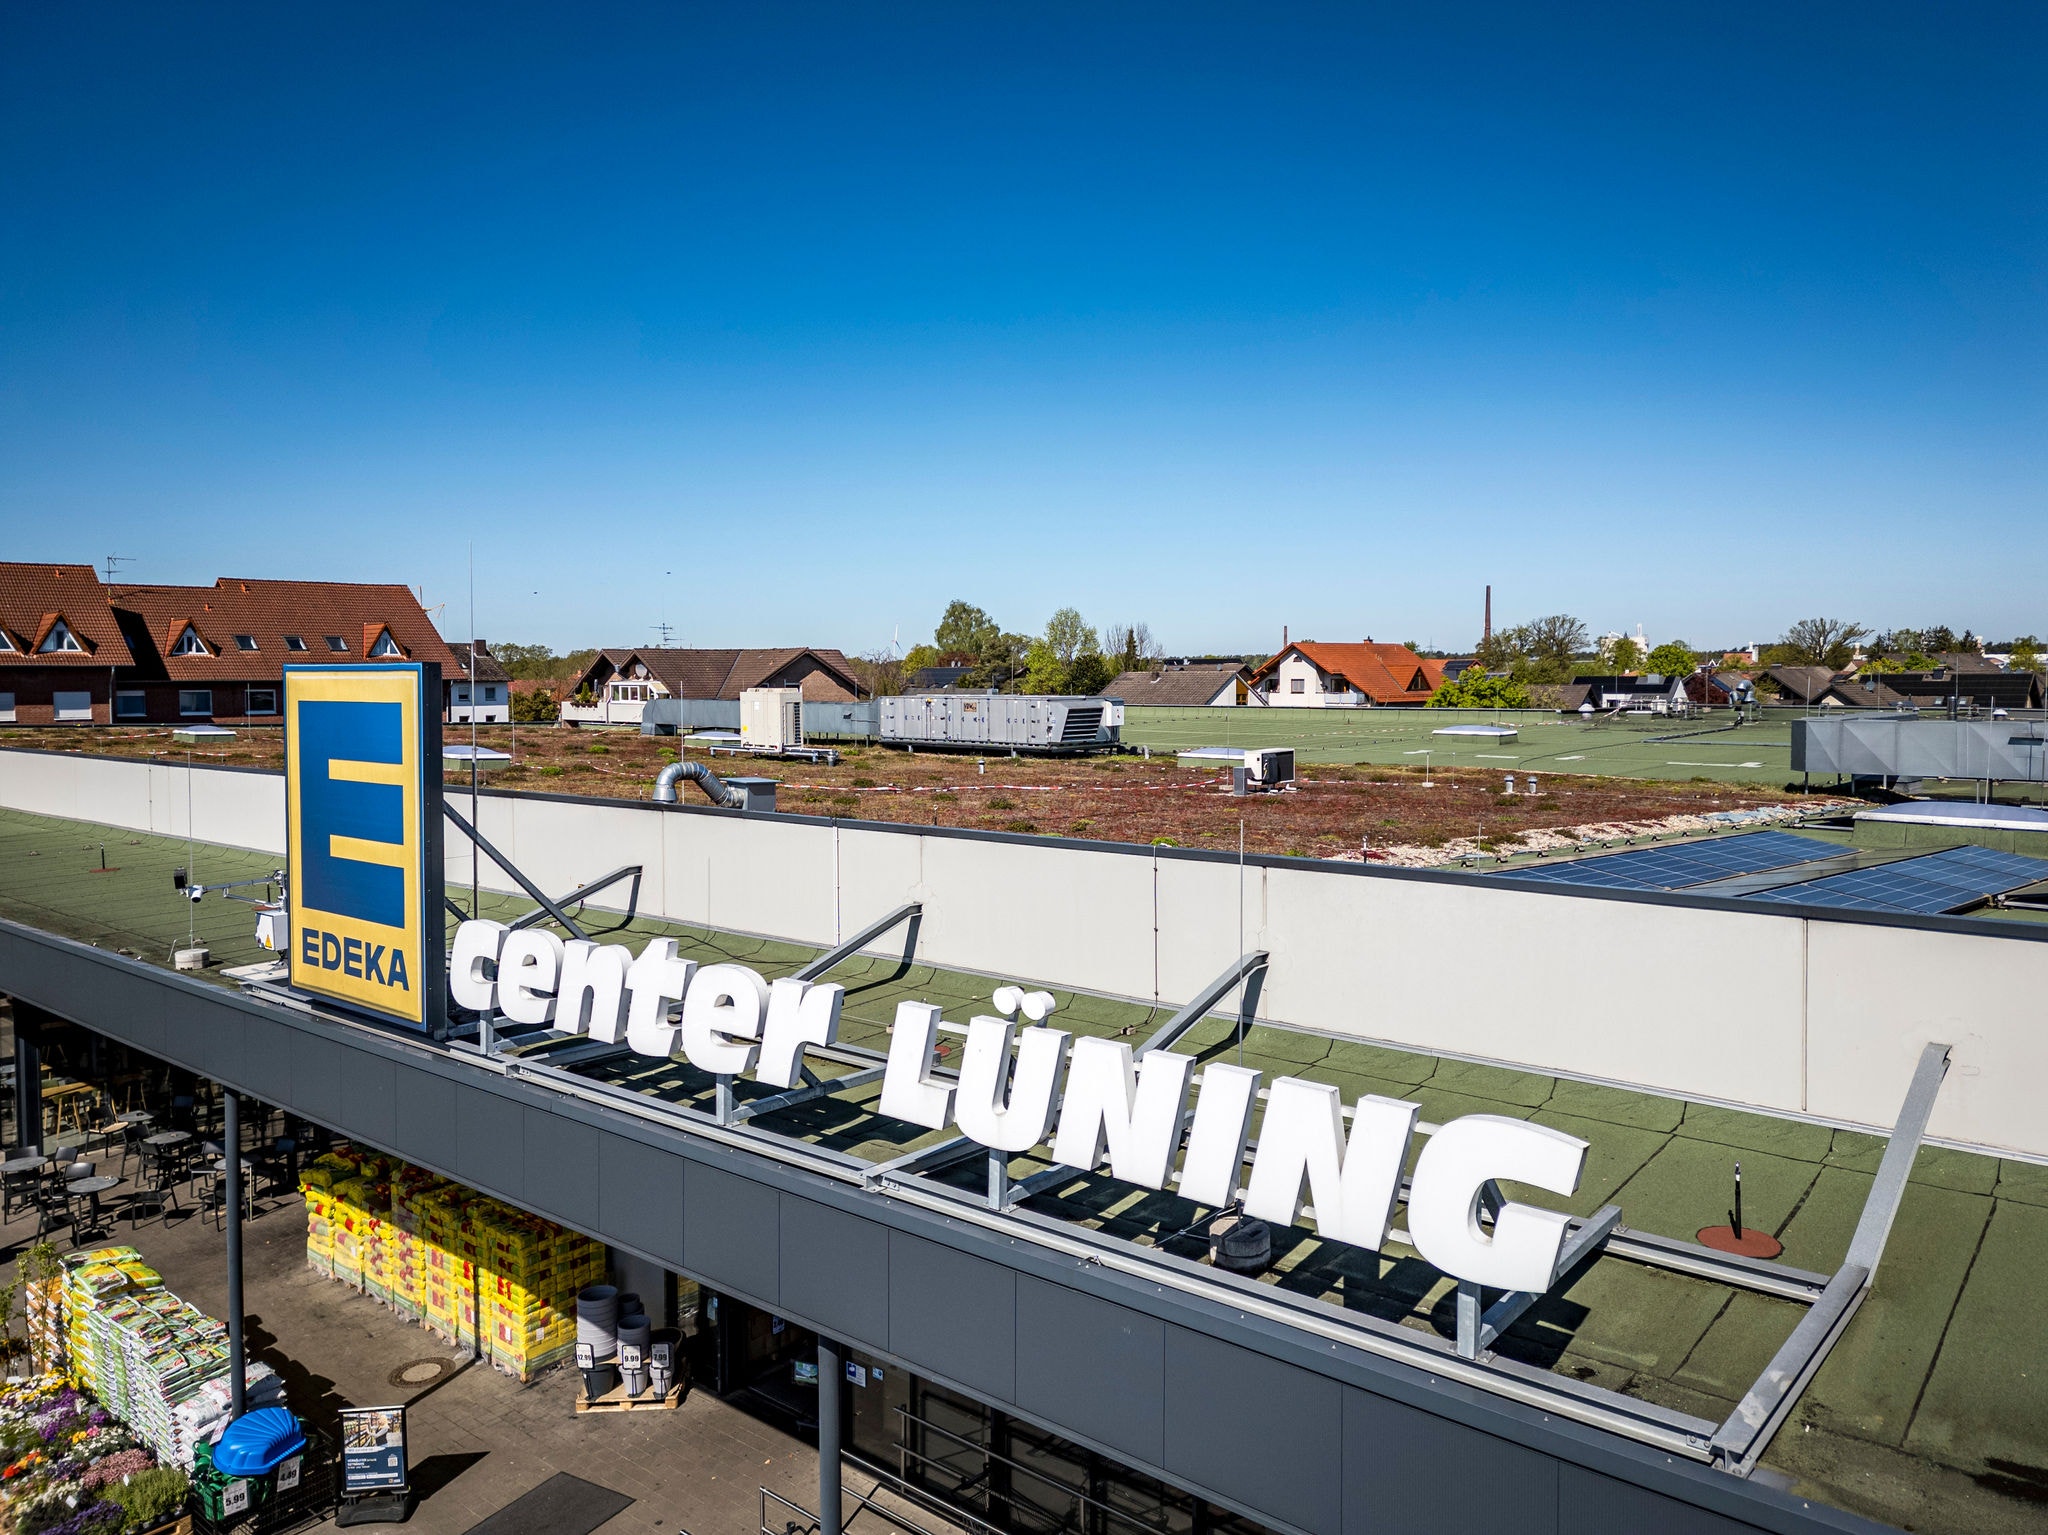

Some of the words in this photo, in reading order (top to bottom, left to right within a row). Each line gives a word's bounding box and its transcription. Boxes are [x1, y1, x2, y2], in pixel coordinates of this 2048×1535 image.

[297, 700, 405, 929] E
[301, 927, 410, 992] EDEKA
[449, 917, 846, 1089] center
[878, 985, 1591, 1294] LÜNING
[624, 1354, 640, 1362] 9.99
[653, 1353, 667, 1361] 7.99
[225, 1492, 245, 1507] 5.99
